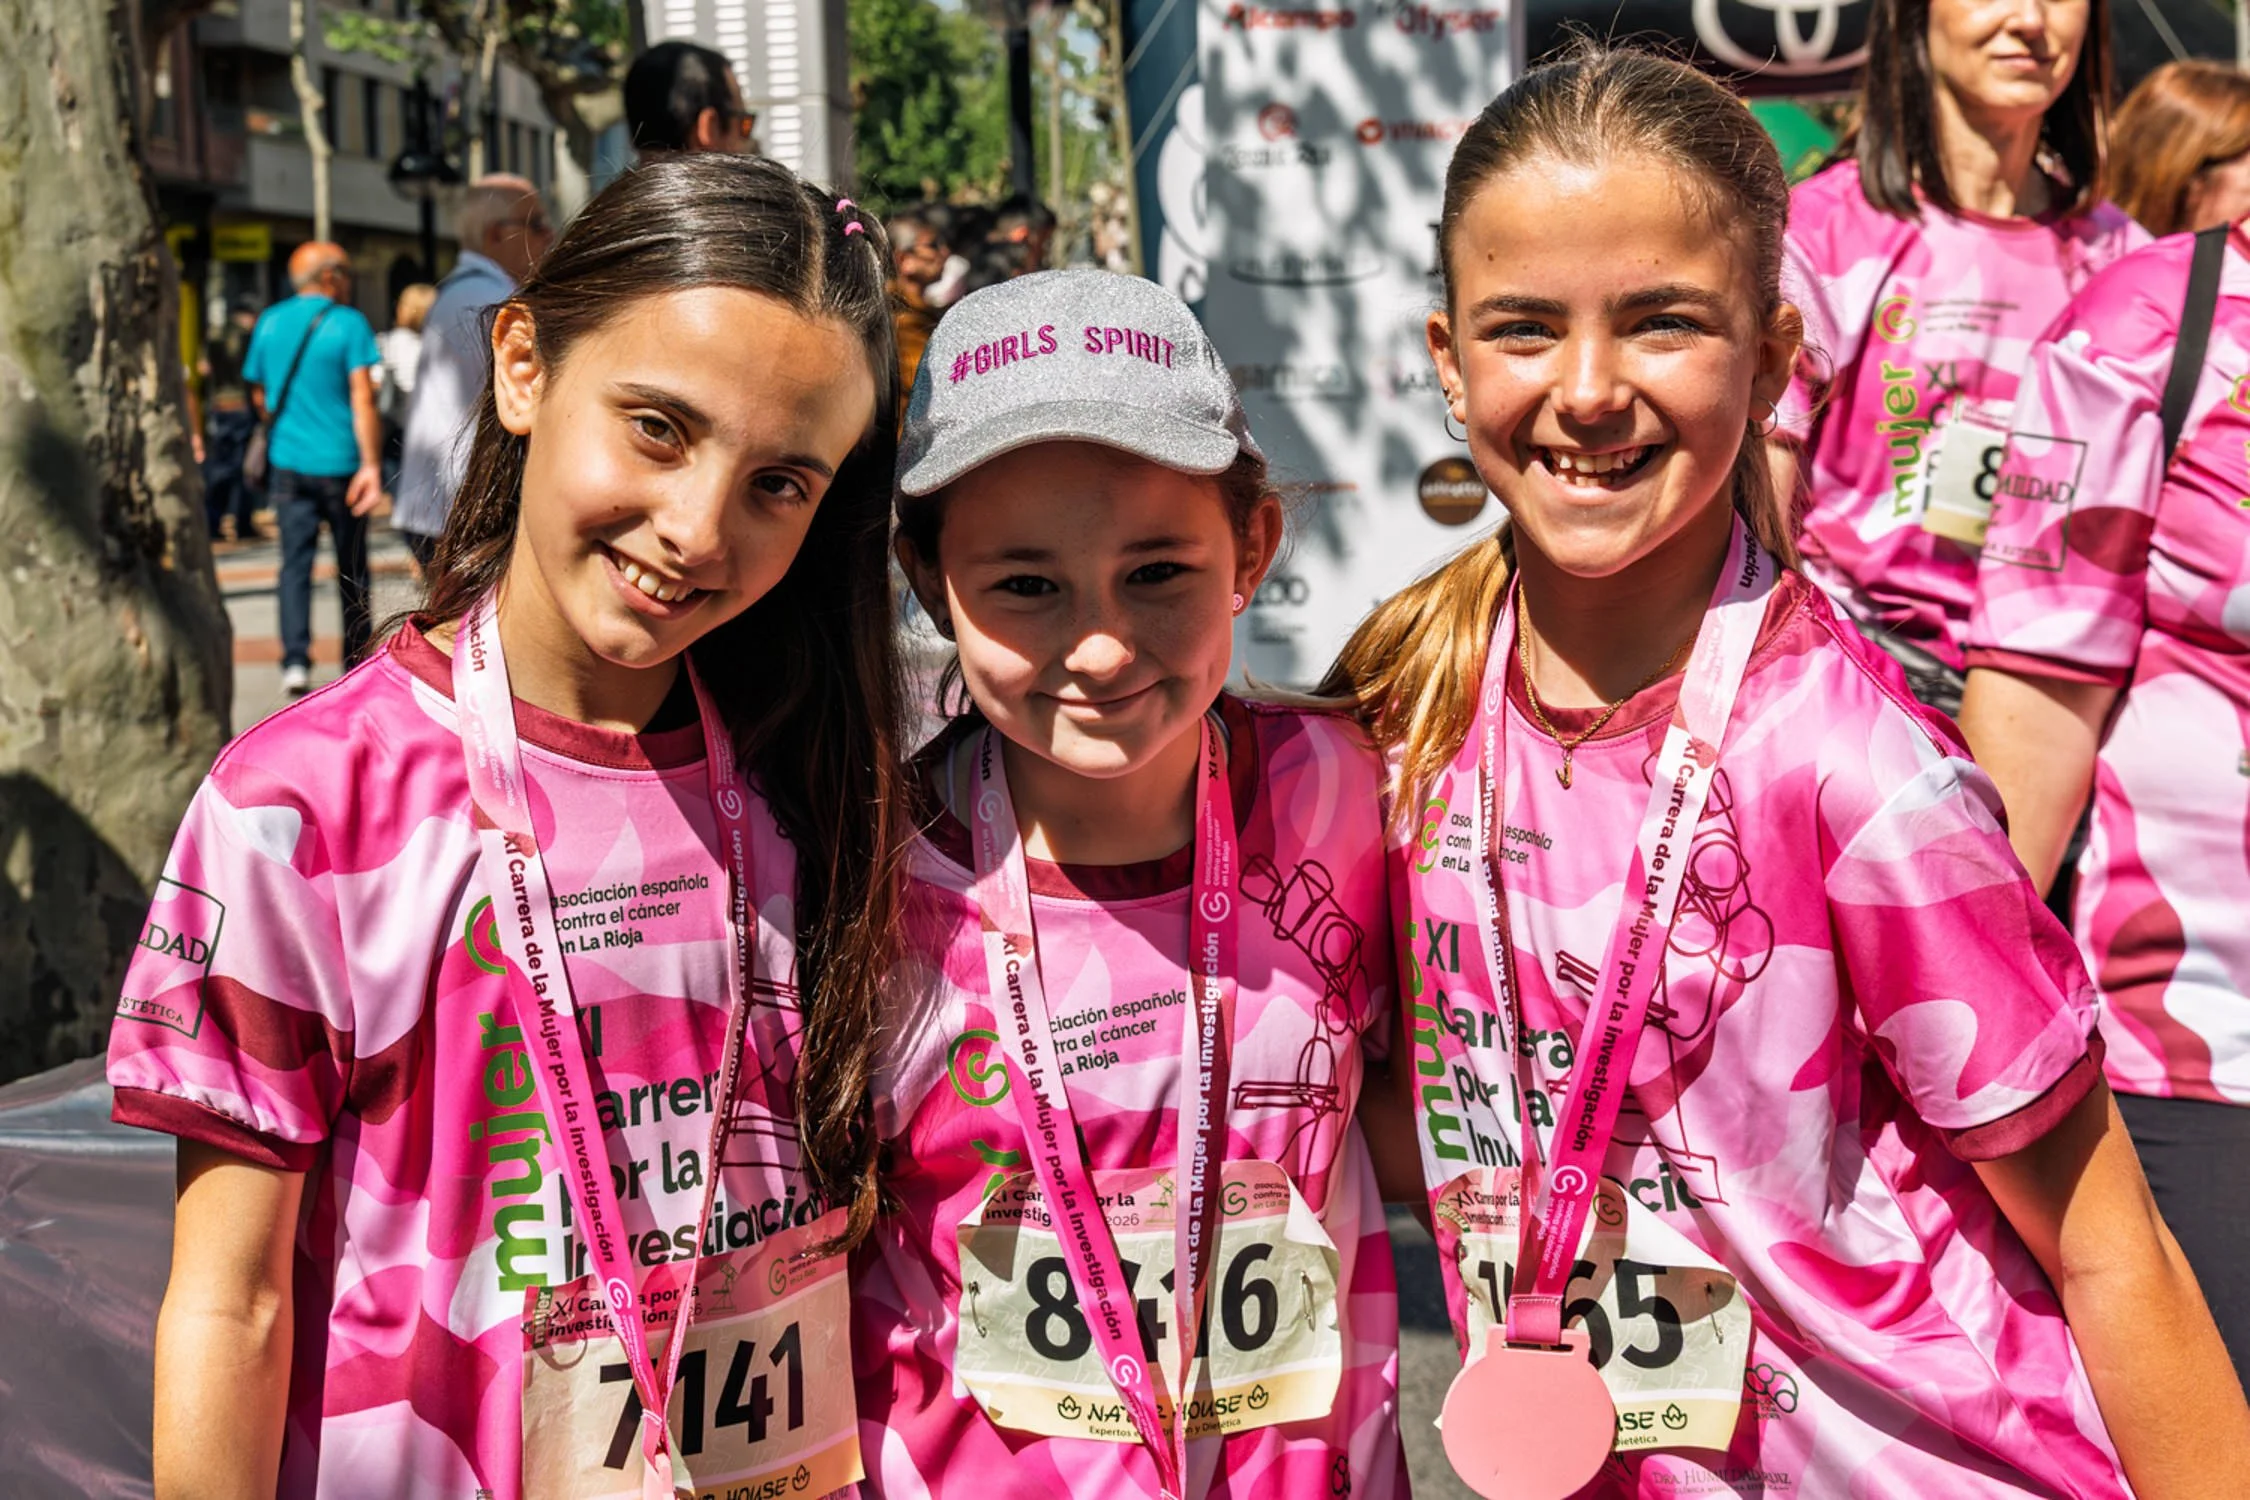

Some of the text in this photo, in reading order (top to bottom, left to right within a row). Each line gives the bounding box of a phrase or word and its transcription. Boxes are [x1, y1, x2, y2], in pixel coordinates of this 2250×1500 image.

[949, 325, 1175, 384] #GIRLS SPIRIT
[1876, 361, 1932, 517] mujer
[1441, 855, 1471, 873] en La
[551, 873, 709, 909] asociación española
[554, 901, 681, 934] contra el cáncer
[581, 935, 601, 952] La
[605, 927, 643, 950] Rioja
[1425, 917, 1460, 974] XI
[1571, 738, 1700, 1152] XI Carrera de la Mujer por la investigación
[1200, 932, 1222, 1067] investigación
[504, 835, 615, 1263] XI Carrera de la Mujer por la investigación
[1082, 1029, 1098, 1047] el
[1101, 1017, 1157, 1042] cáncer
[1078, 1050, 1120, 1074] Rioja
[1199, 1070, 1212, 1091] la
[1197, 1093, 1211, 1131] por
[1510, 1072, 1555, 1128] la
[470, 1011, 554, 1293] mujer
[1003, 937, 1122, 1340] XI Carrera de la Mujer por la investigación
[661, 1140, 704, 1194] la
[1190, 1133, 1209, 1194] Mujer
[1117, 1192, 1136, 1206] la
[1190, 1196, 1205, 1216] la
[1189, 1221, 1202, 1247] de
[651, 1289, 680, 1309] por
[1478, 1259, 1684, 1369] 165
[599, 1322, 804, 1469] 7141
[1089, 1426, 1132, 1438] Expertos
